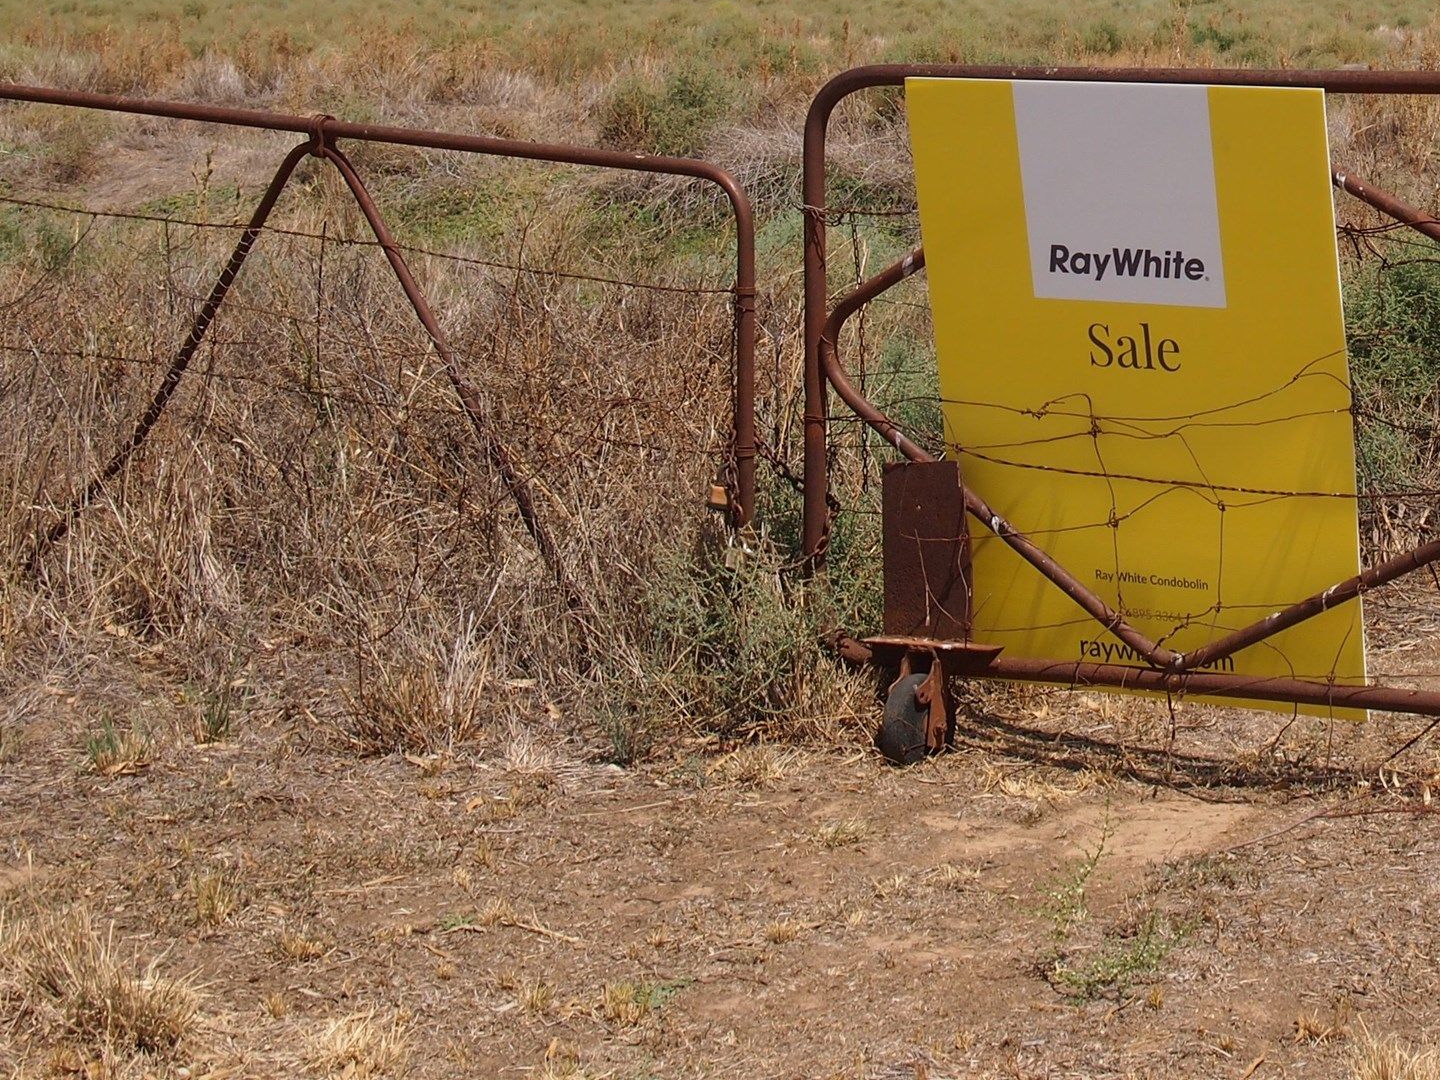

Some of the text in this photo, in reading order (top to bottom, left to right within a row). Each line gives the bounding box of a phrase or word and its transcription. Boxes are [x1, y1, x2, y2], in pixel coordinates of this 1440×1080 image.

[1087, 322, 1181, 372] Sale
[1095, 569, 1208, 591] Ray White Condobolin
